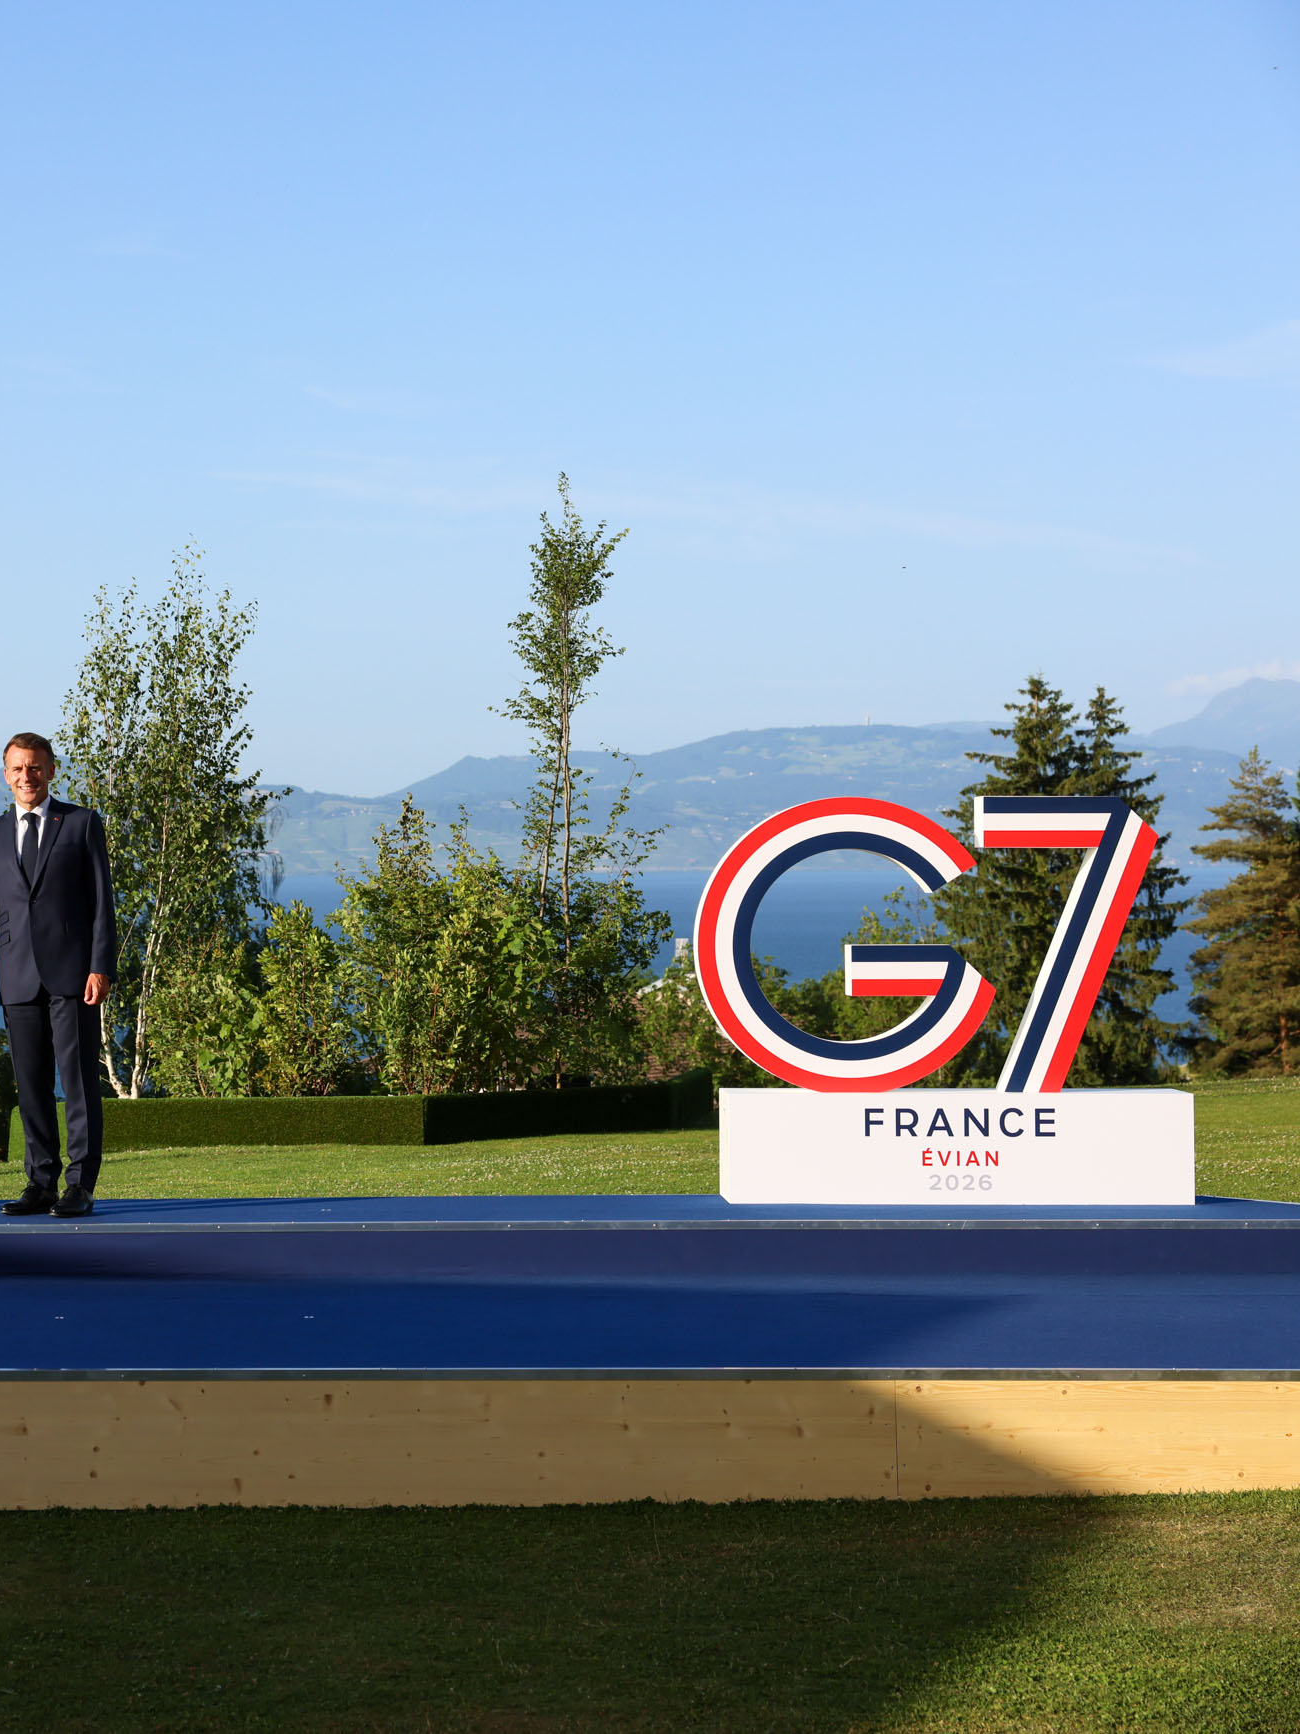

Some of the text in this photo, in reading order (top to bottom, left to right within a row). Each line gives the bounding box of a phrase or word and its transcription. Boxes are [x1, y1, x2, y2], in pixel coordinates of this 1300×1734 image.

[694, 796, 1158, 1093] G7
[864, 1107, 1057, 1137] FRANCE
[921, 1148, 999, 1167] ÉVIAN
[928, 1173, 993, 1191] 2026
